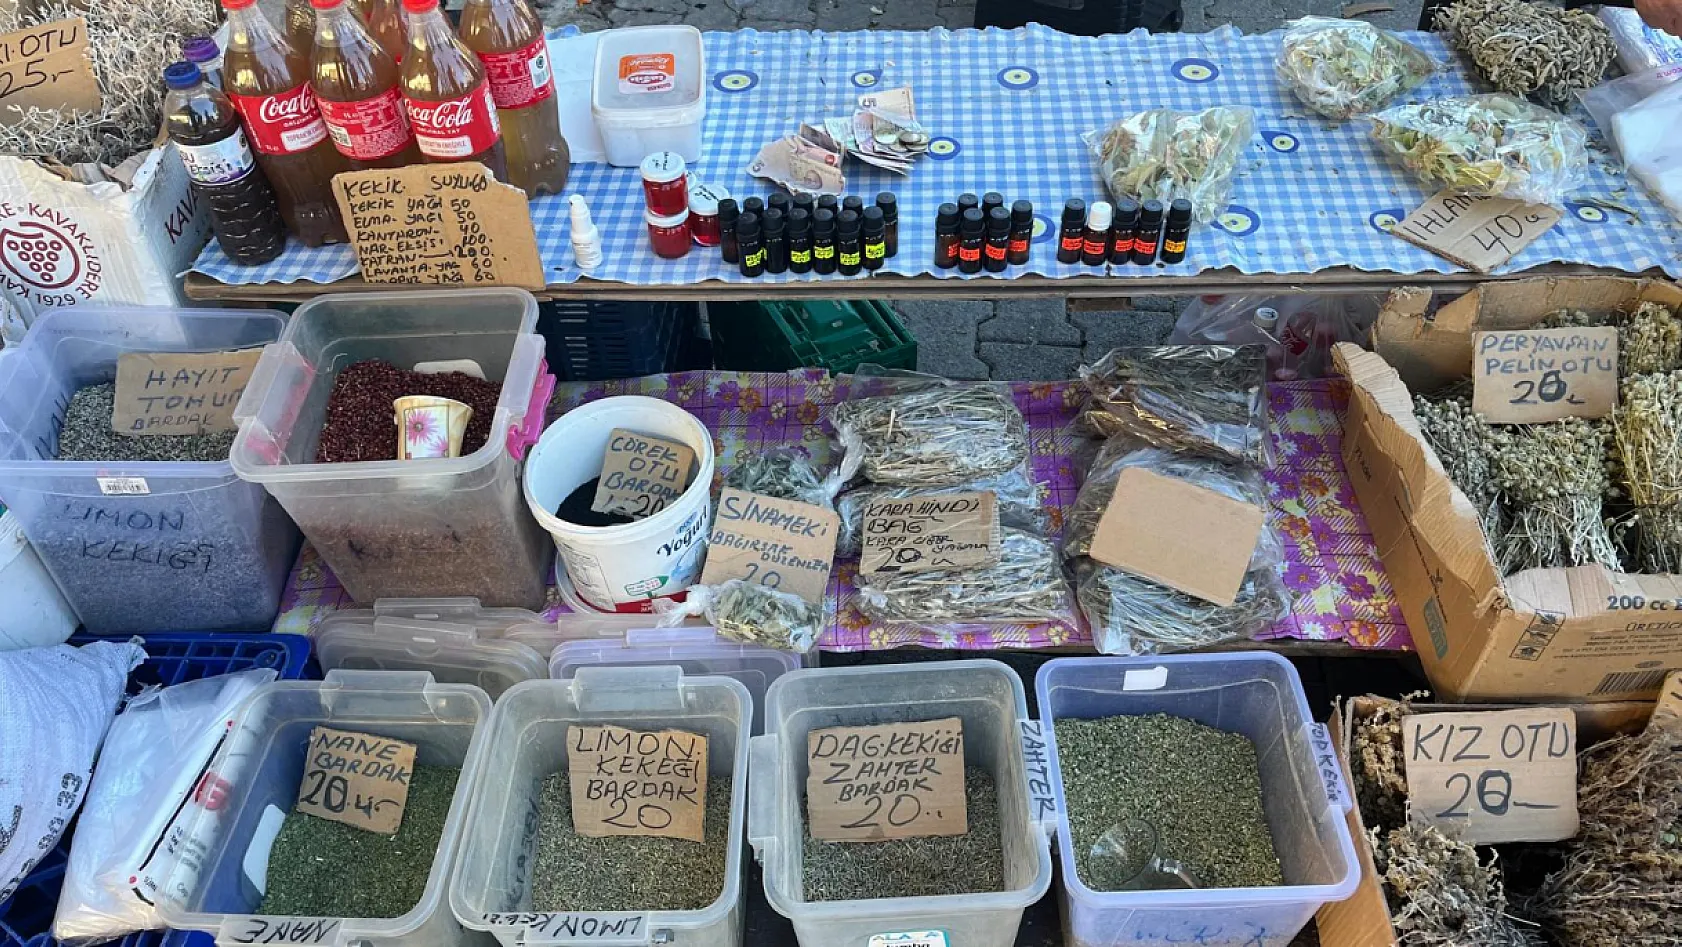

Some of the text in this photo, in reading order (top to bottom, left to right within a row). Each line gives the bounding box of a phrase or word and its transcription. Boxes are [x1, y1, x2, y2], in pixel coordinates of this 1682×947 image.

[20, 26, 77, 58] OTU
[451, 199, 471, 212] 50
[457, 211, 476, 224] 50
[459, 224, 480, 235] 40
[471, 258, 492, 269] 60
[474, 268, 496, 282] 60
[37, 293, 76, 307] 1929
[144, 366, 241, 389] HAYIT
[1561, 356, 1614, 375] OTU
[629, 456, 679, 482] OTU
[1607, 595, 1646, 611] 200
[315, 732, 402, 762] NANE
[1500, 721, 1570, 763] OTU
[314, 752, 411, 785] BARDAK
[823, 757, 942, 785] ZAHTER
[1021, 721, 1057, 821] ZAHTER
[587, 780, 699, 806] BARDAK
[601, 797, 672, 829] 20
